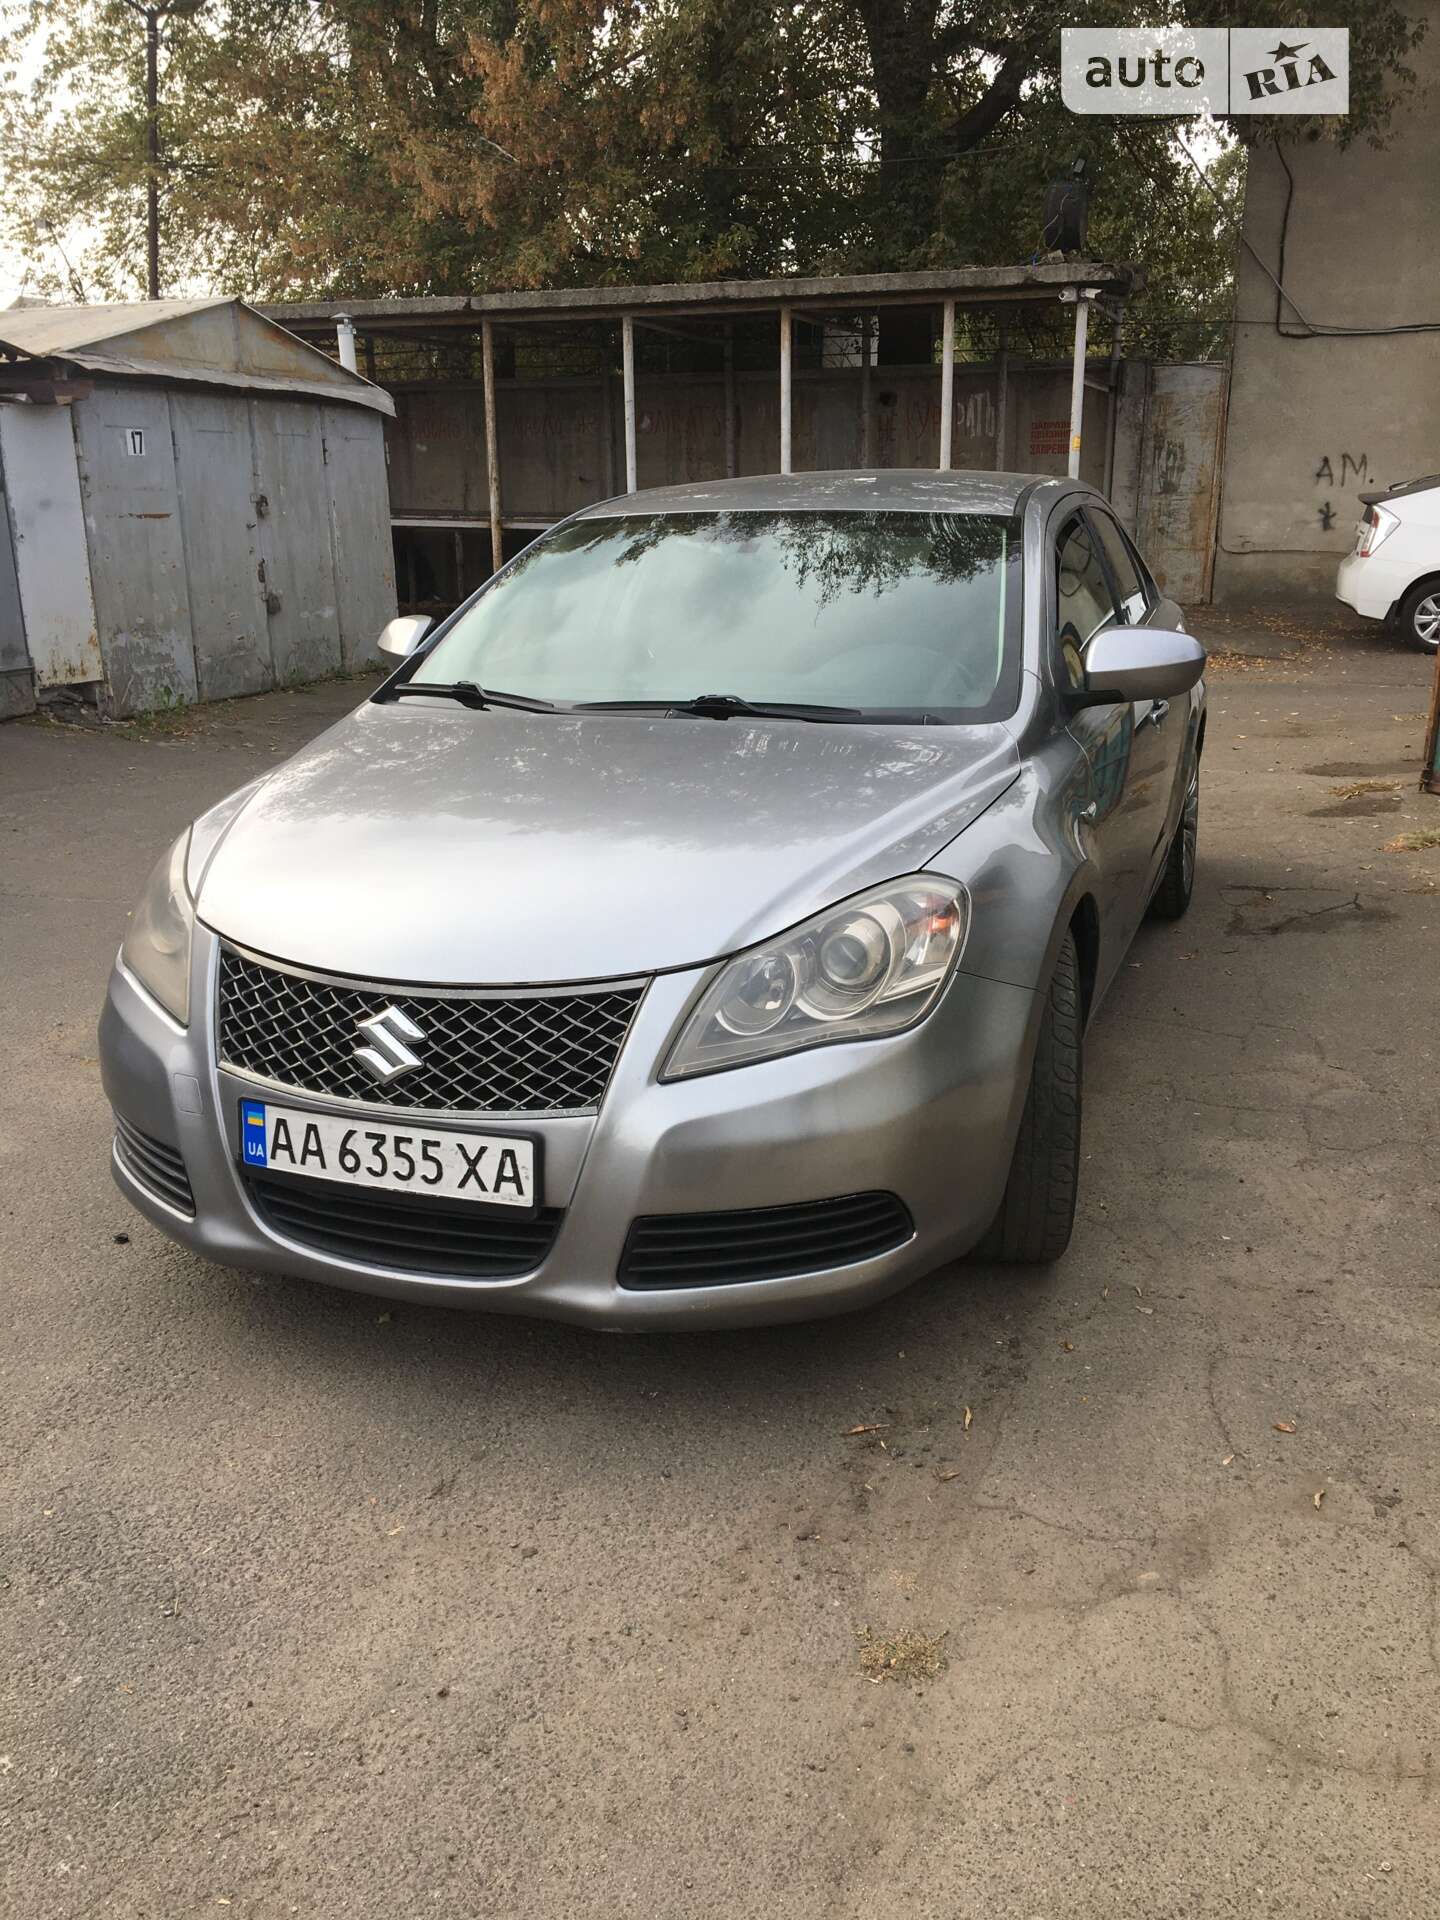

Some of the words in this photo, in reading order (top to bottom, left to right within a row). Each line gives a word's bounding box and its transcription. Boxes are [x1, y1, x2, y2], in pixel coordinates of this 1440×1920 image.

[131, 431, 143, 454] 17
[248, 1142, 265, 1158] UA
[270, 1117, 327, 1170] AA
[338, 1129, 444, 1185] 6355
[456, 1142, 524, 1196] XA
